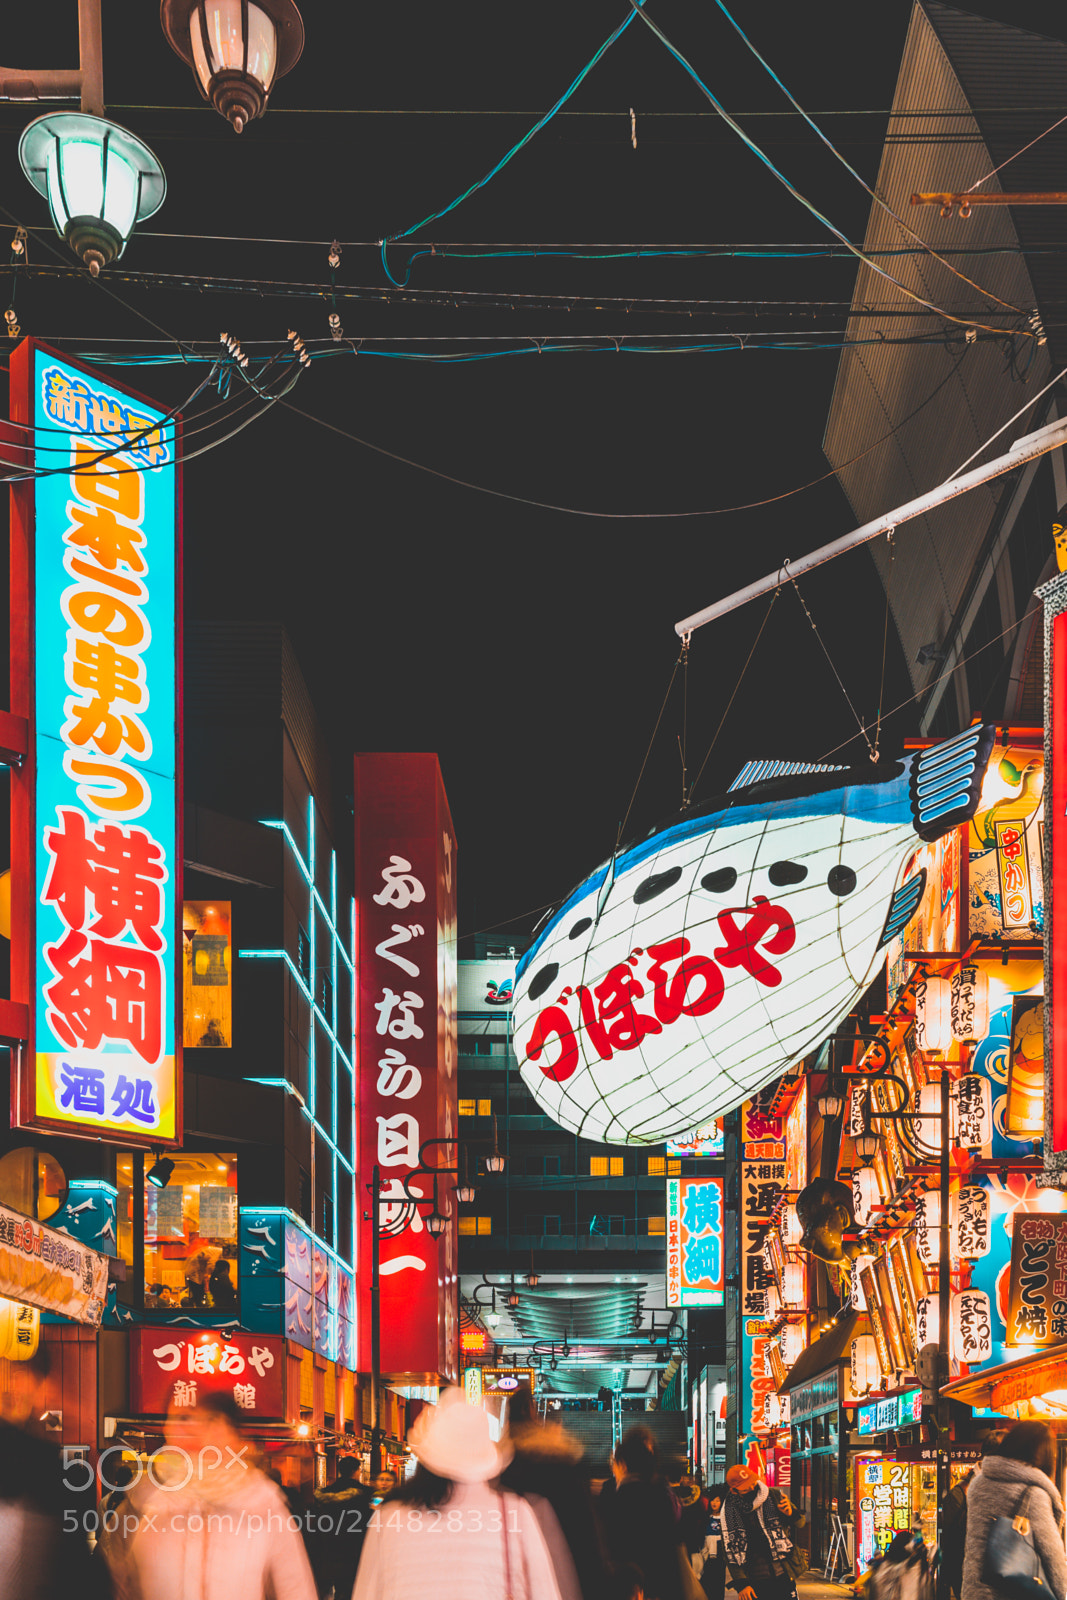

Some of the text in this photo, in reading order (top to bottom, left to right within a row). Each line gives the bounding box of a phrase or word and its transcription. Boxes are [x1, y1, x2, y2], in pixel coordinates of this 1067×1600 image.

[42, 365, 170, 472] 新世界
[60, 434, 151, 818] 日本一の串かつ
[1000, 827, 1026, 922] 串かつ
[41, 805, 168, 1066] 横綱
[526, 895, 797, 1082] づぼらや
[56, 1061, 159, 1129] 酒処
[372, 855, 426, 1276] ふぐなら日本一
[744, 1164, 785, 1180] 大相撲
[681, 1181, 722, 1286] 横綱
[1021, 1219, 1055, 1240] 名物
[153, 1341, 275, 1377] づぼらや
[778, 1455, 791, 1486] COIN
